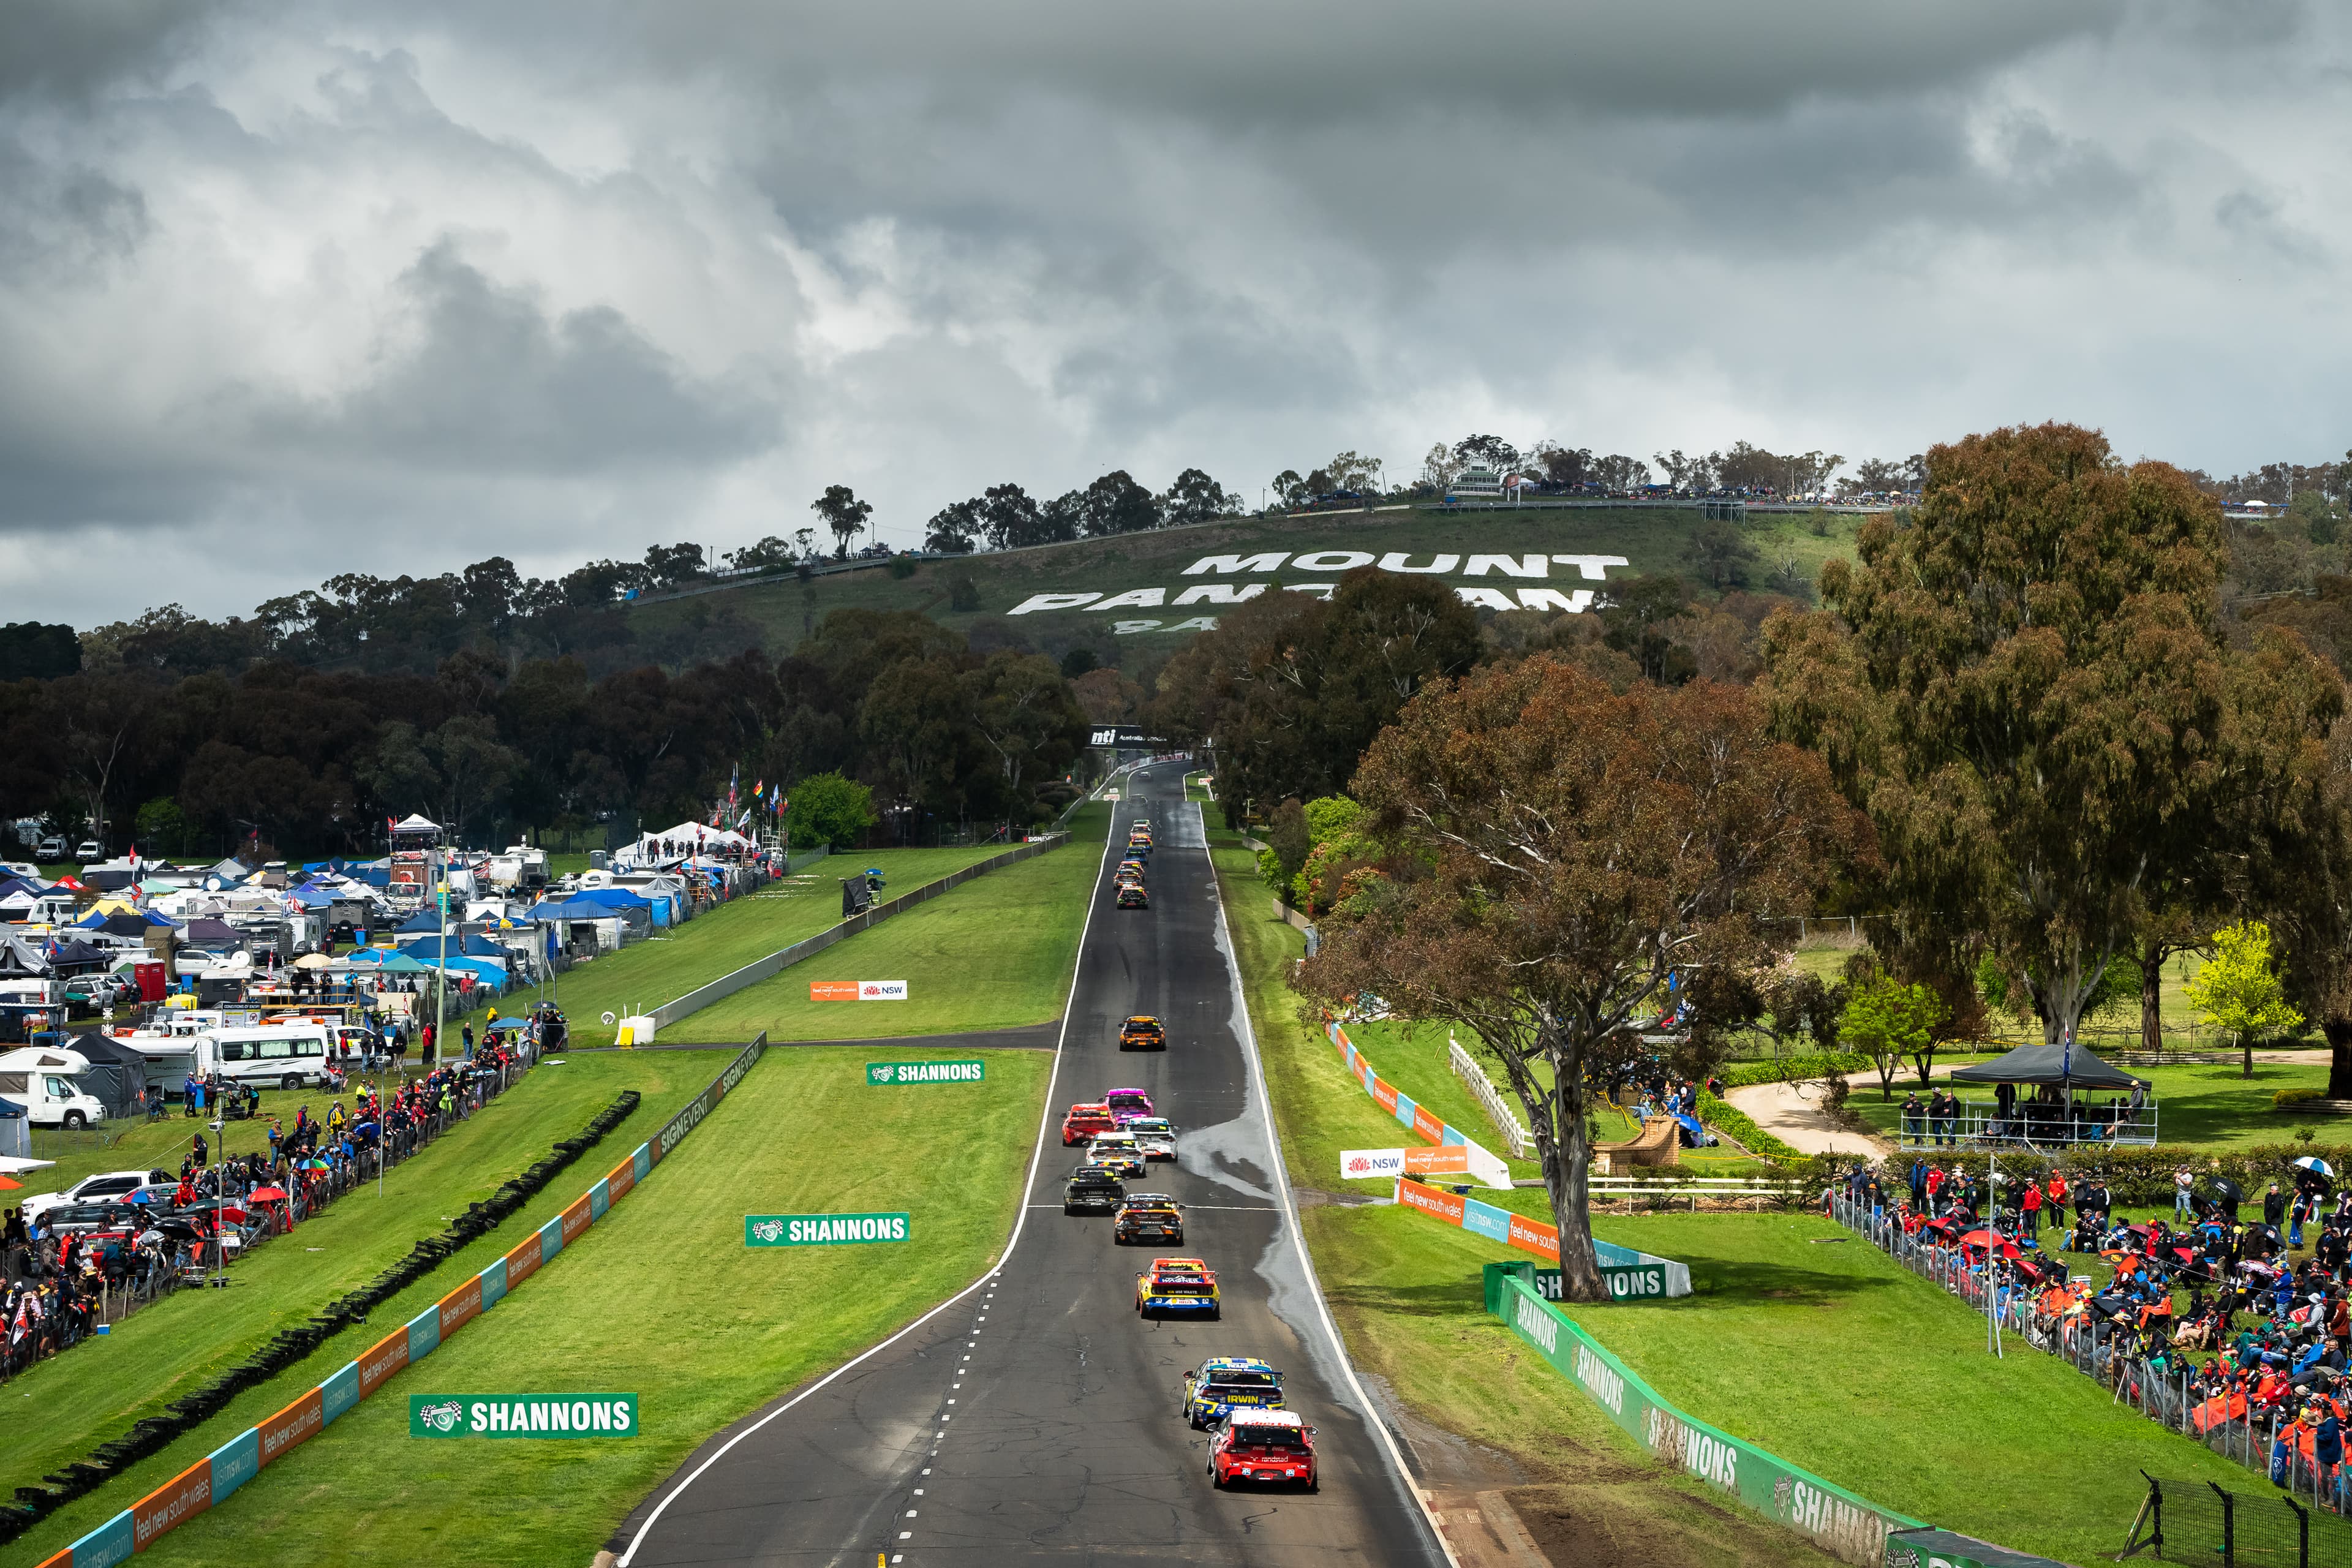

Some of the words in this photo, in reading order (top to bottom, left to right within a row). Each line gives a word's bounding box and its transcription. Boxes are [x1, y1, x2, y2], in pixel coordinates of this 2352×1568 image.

[1180, 551, 1629, 580] MOUNT
[1091, 729, 1116, 743] nti
[723, 1043, 760, 1093] SIGNEVENT
[897, 1064, 981, 1082] SHANNONS
[662, 1095, 707, 1153] SIGNEVENT
[1373, 1158, 1400, 1169] NSW
[1403, 1187, 1415, 1204] feel
[1415, 1193, 1428, 1207] new
[1428, 1197, 1445, 1213] south
[1445, 1201, 1461, 1218] wales
[789, 1218, 905, 1242] SHANNONS
[1466, 1207, 1507, 1232] visitnsw.com
[1510, 1221, 1523, 1240] feel
[1523, 1229, 1538, 1245] new
[1539, 1233, 1557, 1251] south
[451, 1303, 459, 1321] new
[459, 1294, 470, 1315] south
[470, 1289, 480, 1306] wales
[410, 1321, 438, 1351] visitnsw.com
[1517, 1294, 1558, 1354] SHANNONS
[363, 1363, 372, 1386] feel
[372, 1361, 382, 1378] new
[382, 1347, 396, 1371] south
[395, 1341, 407, 1362] wales
[325, 1378, 358, 1412] visitnsw.com
[1577, 1344, 1624, 1415] SHANNONS
[1227, 1395, 1258, 1404] IRWIN
[265, 1428, 276, 1455] feel
[277, 1425, 290, 1447] new
[290, 1411, 306, 1438] south
[306, 1403, 321, 1425] wales
[470, 1401, 630, 1432] SHANNONS
[214, 1447, 255, 1488] visitnsw.com
[136, 1512, 152, 1543] feel
[152, 1508, 169, 1532] new
[169, 1487, 189, 1521] south
[189, 1478, 209, 1503] wales
